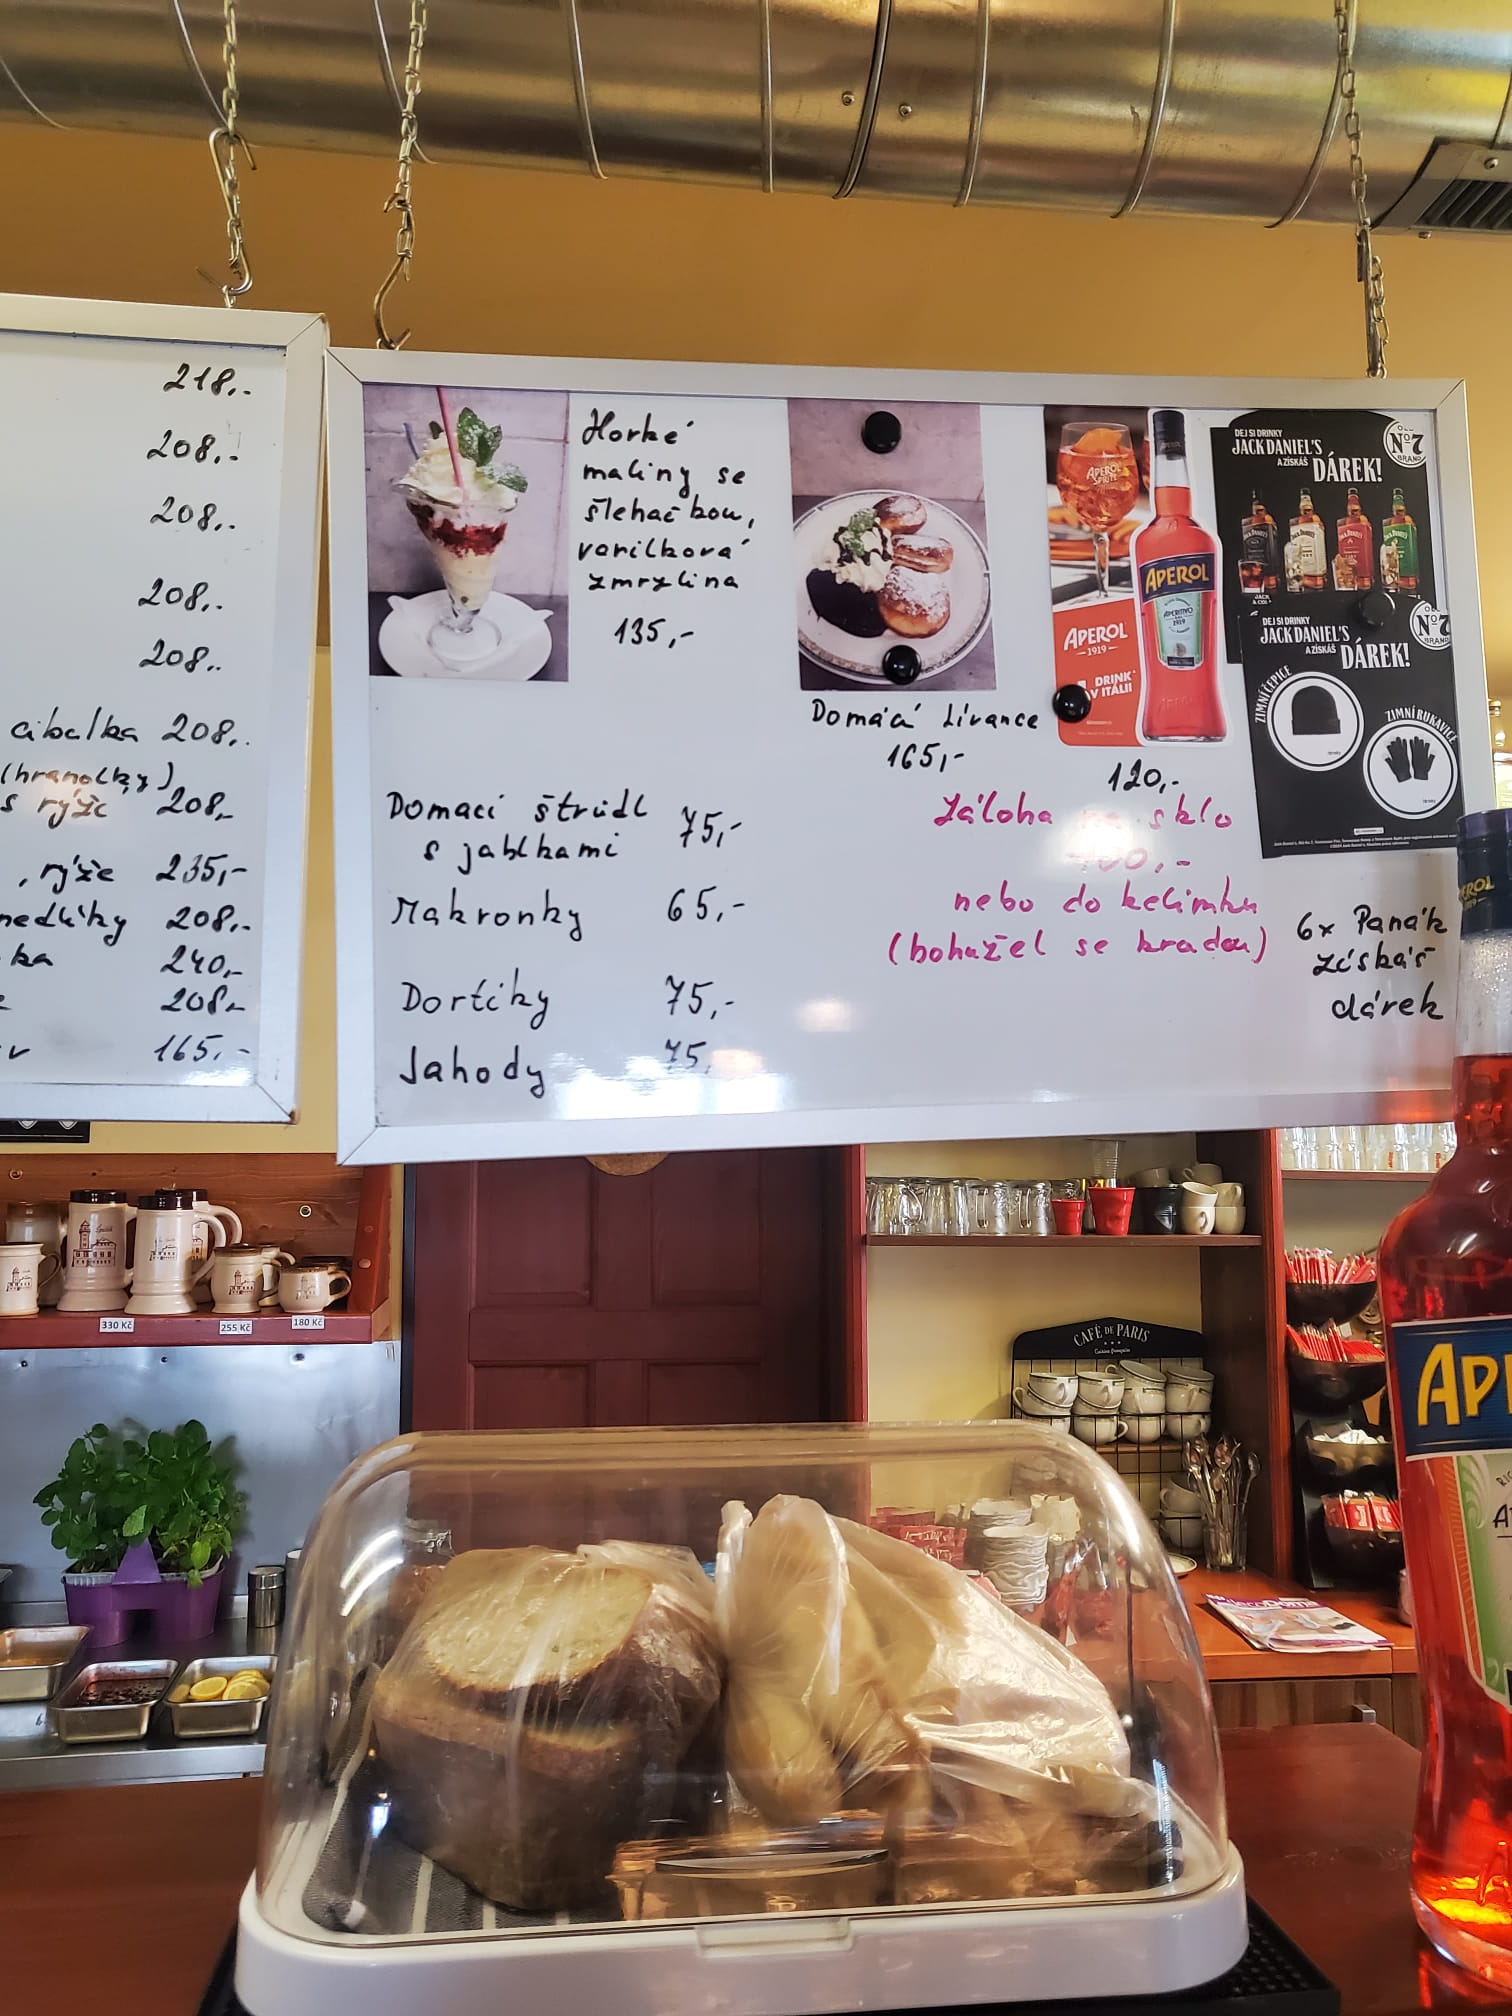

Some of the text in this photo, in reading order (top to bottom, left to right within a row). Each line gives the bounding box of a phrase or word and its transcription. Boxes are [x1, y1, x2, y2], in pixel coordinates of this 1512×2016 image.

[581, 407, 694, 445] Horké
[1234, 429, 1283, 438] DEJ SI DRINKY
[1232, 438, 1323, 455] JACK DANIEL'S
[583, 459, 746, 499] maliny se
[1312, 451, 1383, 482] DÁREK!
[584, 494, 754, 529] šlehačkou,
[588, 570, 739, 592] zmrzlina
[1145, 563, 1209, 594] APEROL
[614, 617, 694, 649] 135,-
[1063, 622, 1128, 651] APEROL
[1260, 625, 1350, 644] JACK DANIEL'S
[1262, 616, 1310, 626] DEJ SI DRINKY
[1087, 645, 1107, 656] 1919
[1340, 637, 1411, 670] DÁREK!
[1090, 688, 1098, 699] V
[1101, 682, 1133, 697] ITÁLII
[1255, 664, 1293, 723] ZIMNÍ ČEPICE
[1384, 704, 1459, 744] ZIMNÍ RUKAVICE
[887, 742, 965, 773] 165,-
[1107, 758, 1180, 794] 120,-
[37, 788, 107, 829] rýže
[156, 786, 234, 821] 208,-
[933, 791, 1053, 827] Záloha
[1150, 792, 1232, 830] sklo
[680, 806, 743, 848] 75,-
[155, 853, 248, 886] 235,-
[423, 832, 618, 875] s jablkami
[954, 879, 1034, 912] nebo
[1063, 883, 1101, 913] do
[1458, 875, 1495, 901] EROL
[166, 904, 251, 932] 208,-
[391, 885, 746, 941] Makronky 65,-
[1297, 911, 1335, 941] 6x
[1353, 904, 1448, 936] Panák
[888, 925, 1267, 965] (bohužel se kradou)
[1312, 940, 1436, 976] získáš
[160, 945, 243, 980] 240,-
[665, 975, 735, 1020] 75,-
[1331, 981, 1444, 1021] dárek
[154, 1034, 251, 1063] 165,-
[399, 1045, 545, 1099] Jahody
[102, 1319, 132, 1330] 330 Kč
[221, 1322, 251, 1333] 255 Kč
[294, 1316, 323, 1327] 180 Kč
[1073, 1323, 1151, 1346] CAFÉ DE PARIS
[1417, 1343, 1512, 1427] AP
